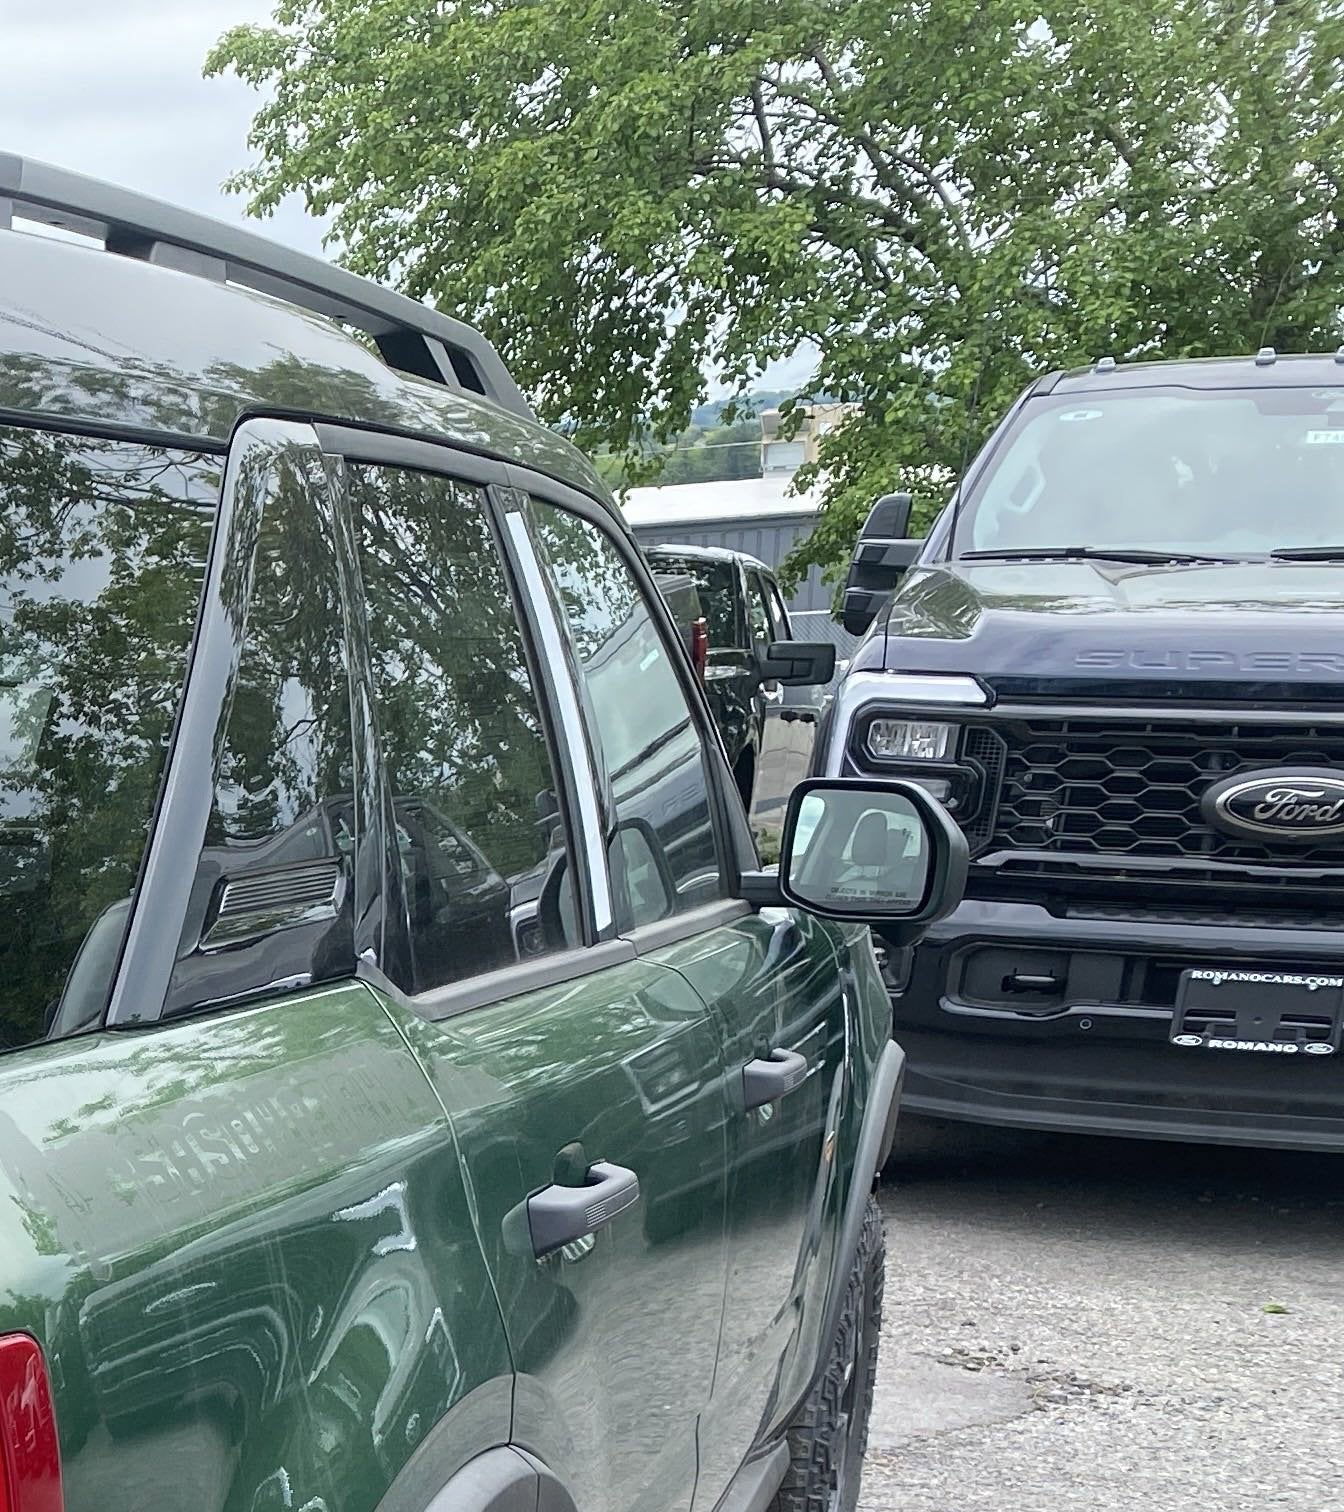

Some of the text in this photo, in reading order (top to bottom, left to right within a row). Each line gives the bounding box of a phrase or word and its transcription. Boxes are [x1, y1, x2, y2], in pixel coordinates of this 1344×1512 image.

[1075, 650, 1344, 672] SUPER
[1253, 788, 1344, 821] Ford
[1191, 970, 1343, 987] ROMANOCARS.COM
[1208, 1039, 1299, 1053] ROMANO
